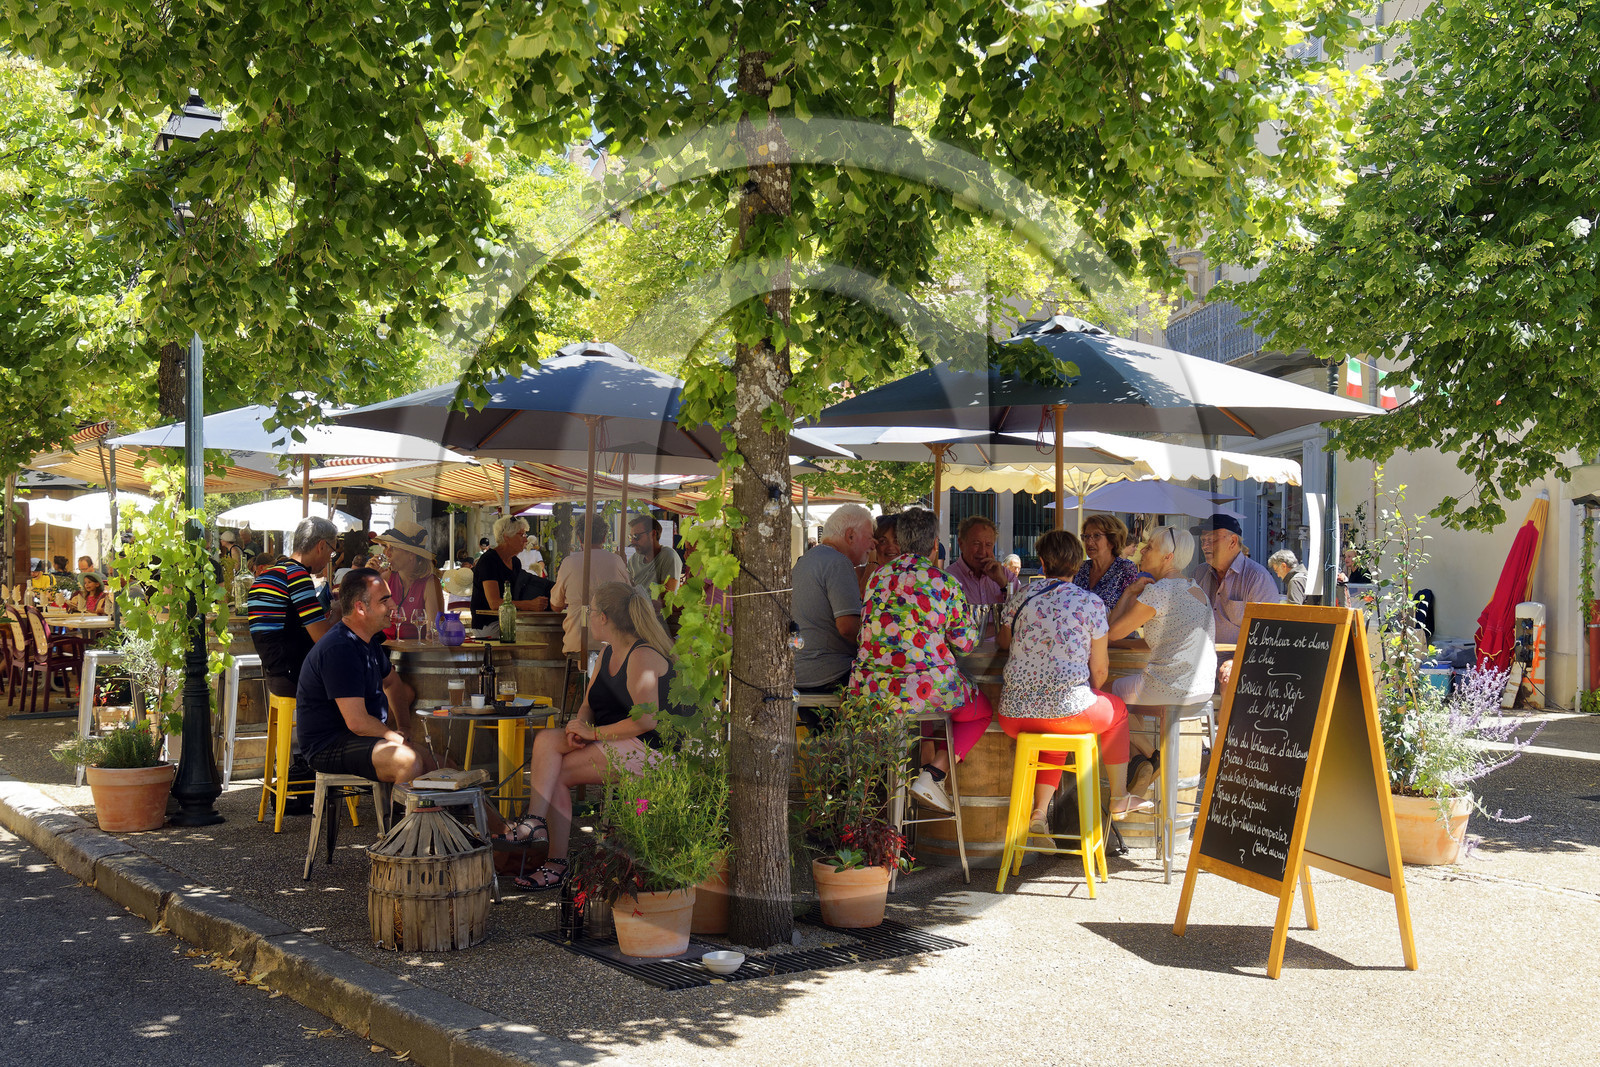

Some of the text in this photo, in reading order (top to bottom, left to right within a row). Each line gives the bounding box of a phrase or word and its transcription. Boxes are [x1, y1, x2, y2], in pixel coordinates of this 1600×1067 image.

[1248, 621, 1330, 651] Le bonheur est dans
[1244, 648, 1276, 665] le chai
[1237, 674, 1262, 695] Service
[1247, 699, 1259, 714] de
[1240, 732, 1249, 749] du
[1269, 743, 1277, 756] et
[1280, 784, 1288, 796] et
[1221, 810, 1229, 827] et
